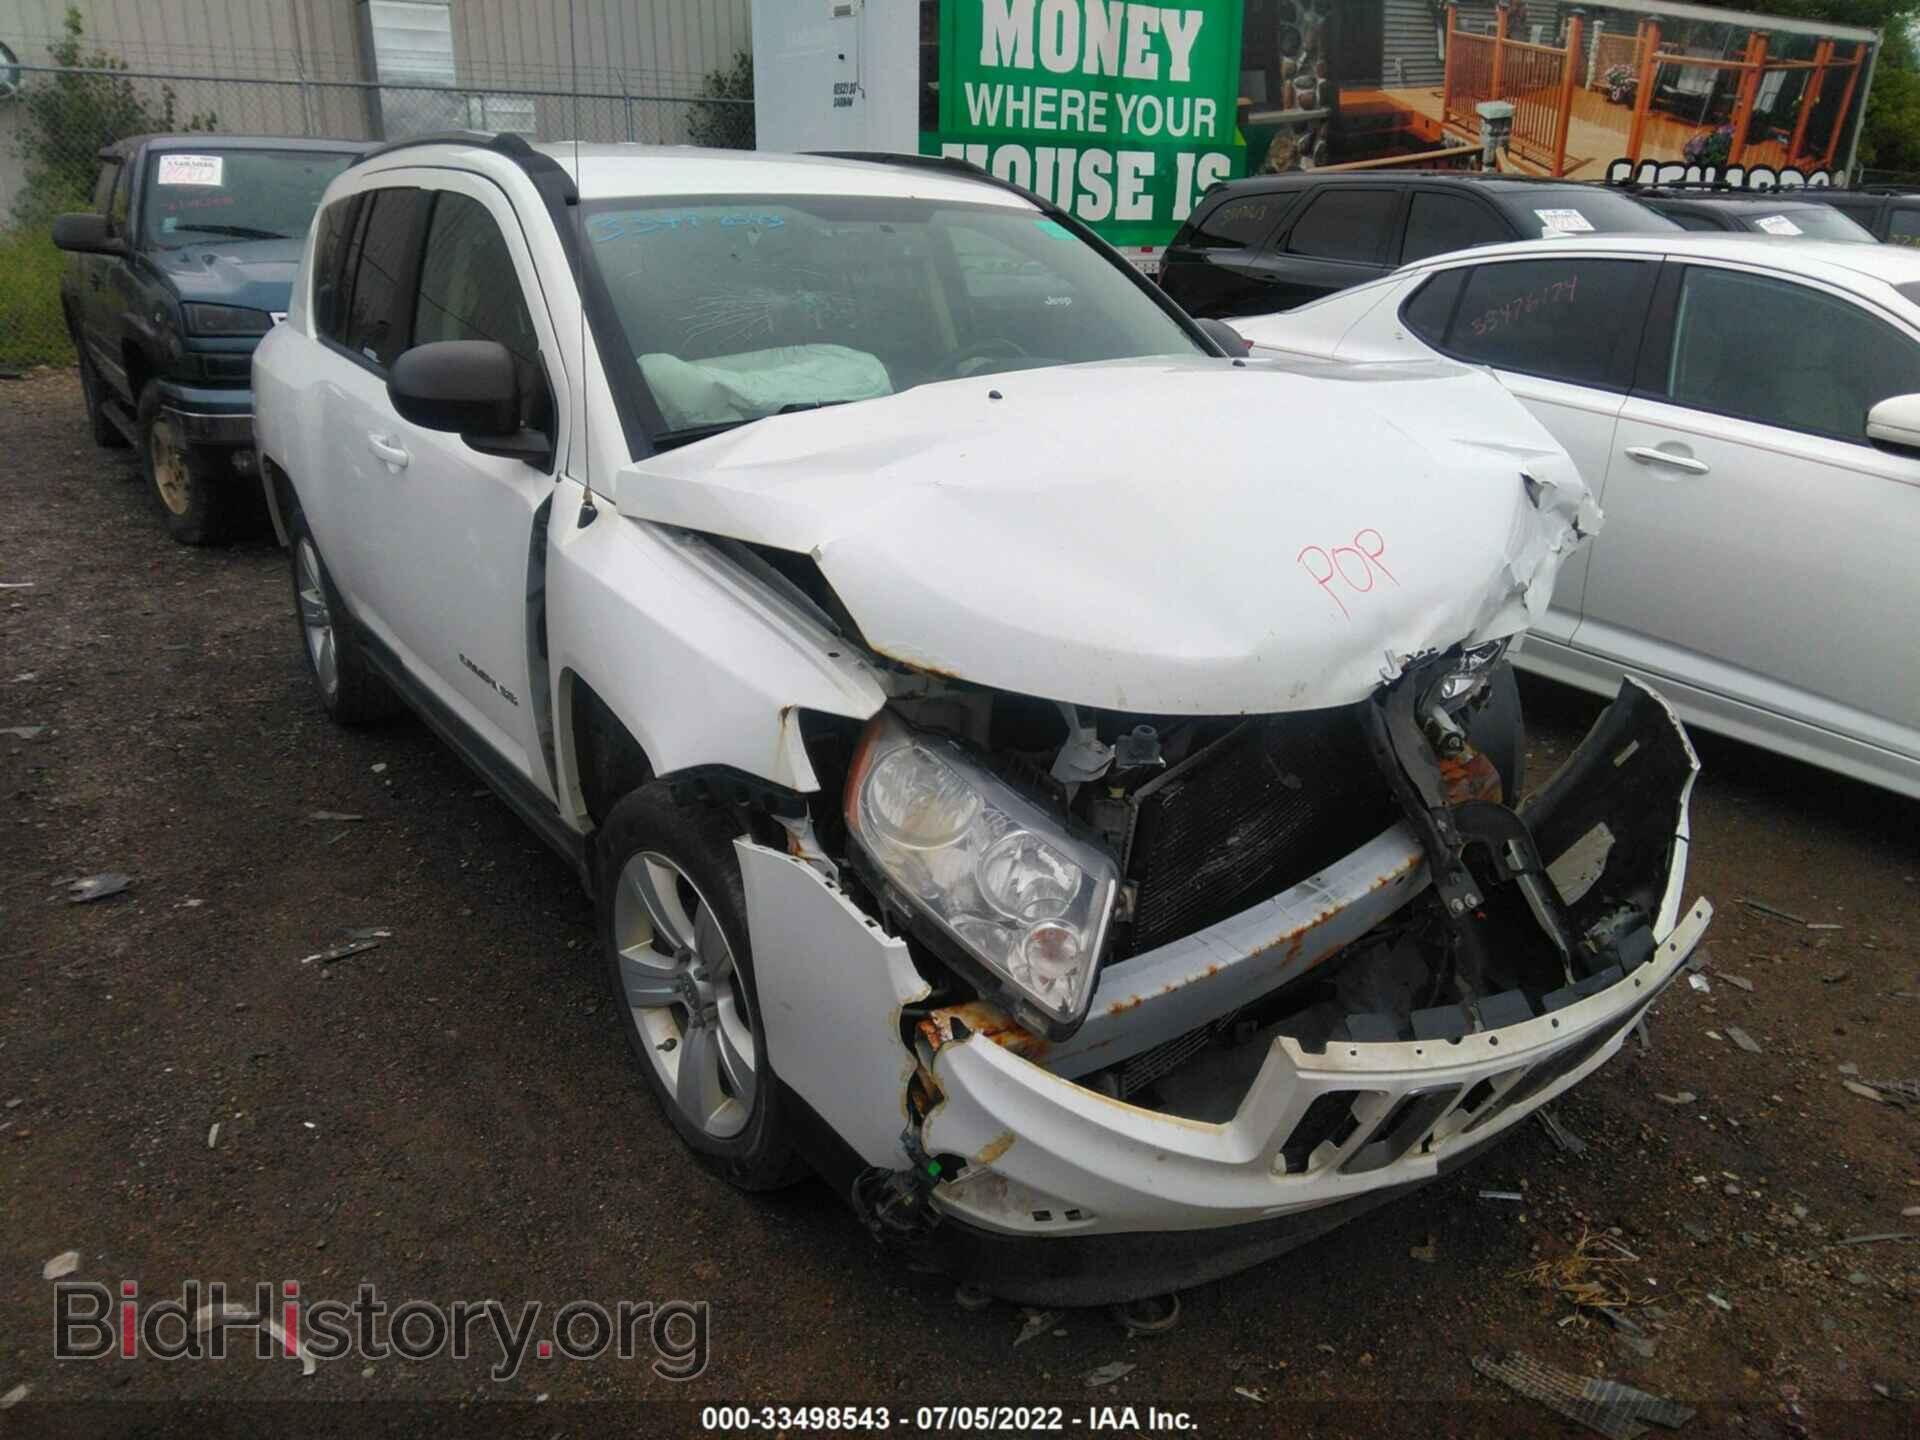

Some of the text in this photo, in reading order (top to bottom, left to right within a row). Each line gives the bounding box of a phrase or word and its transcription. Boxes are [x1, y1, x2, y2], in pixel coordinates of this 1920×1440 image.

[980, 0, 1204, 82] MONEY
[964, 82, 1217, 138] WHERE YOUR
[1297, 528, 1400, 622] POP
